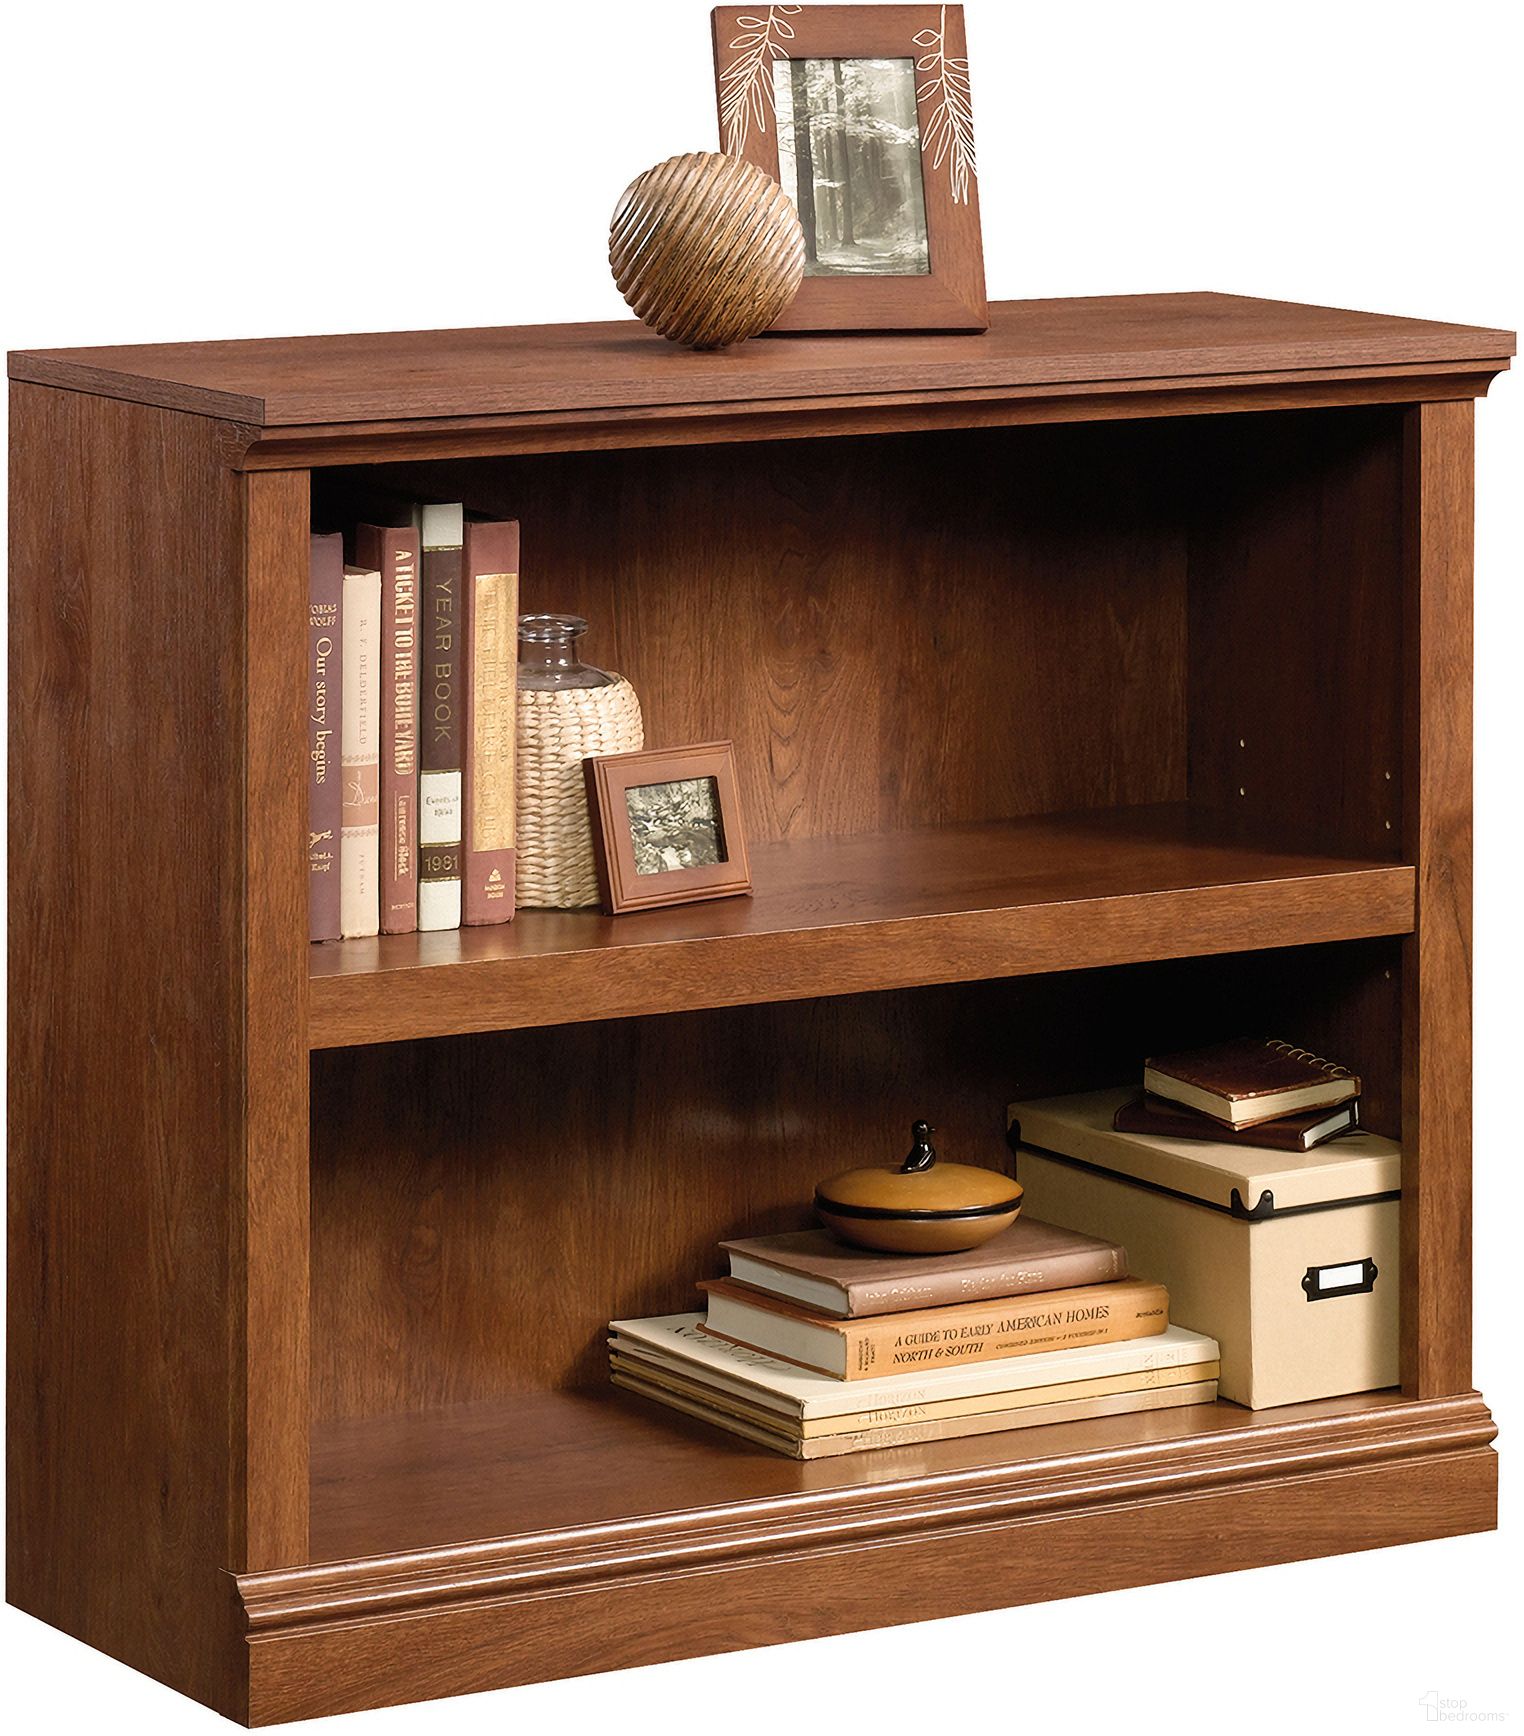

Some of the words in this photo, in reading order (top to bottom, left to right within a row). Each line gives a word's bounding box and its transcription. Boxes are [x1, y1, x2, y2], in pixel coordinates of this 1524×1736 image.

[394, 550, 413, 561] A
[394, 563, 415, 625] TICKET
[434, 578, 452, 650] YEAR
[316, 637, 333, 676] Our
[394, 628, 414, 649] TO
[394, 652, 414, 680] THE
[310, 681, 328, 725] story
[359, 655, 368, 745] DELDERFIELD
[434, 663, 452, 742] BOOK
[310, 730, 333, 786] begins
[425, 855, 459, 872] 1981
[894, 1336, 902, 1347] A
[904, 1331, 940, 1346] GUIDE
[943, 1328, 958, 1341] TO
[960, 1323, 993, 1338] EARLY
[996, 1312, 1063, 1334] AMERICAN
[1066, 1305, 1110, 1323] HOMES
[893, 1348, 933, 1364] NORTH
[934, 1347, 944, 1358] &
[944, 1342, 984, 1357] SOUTH
